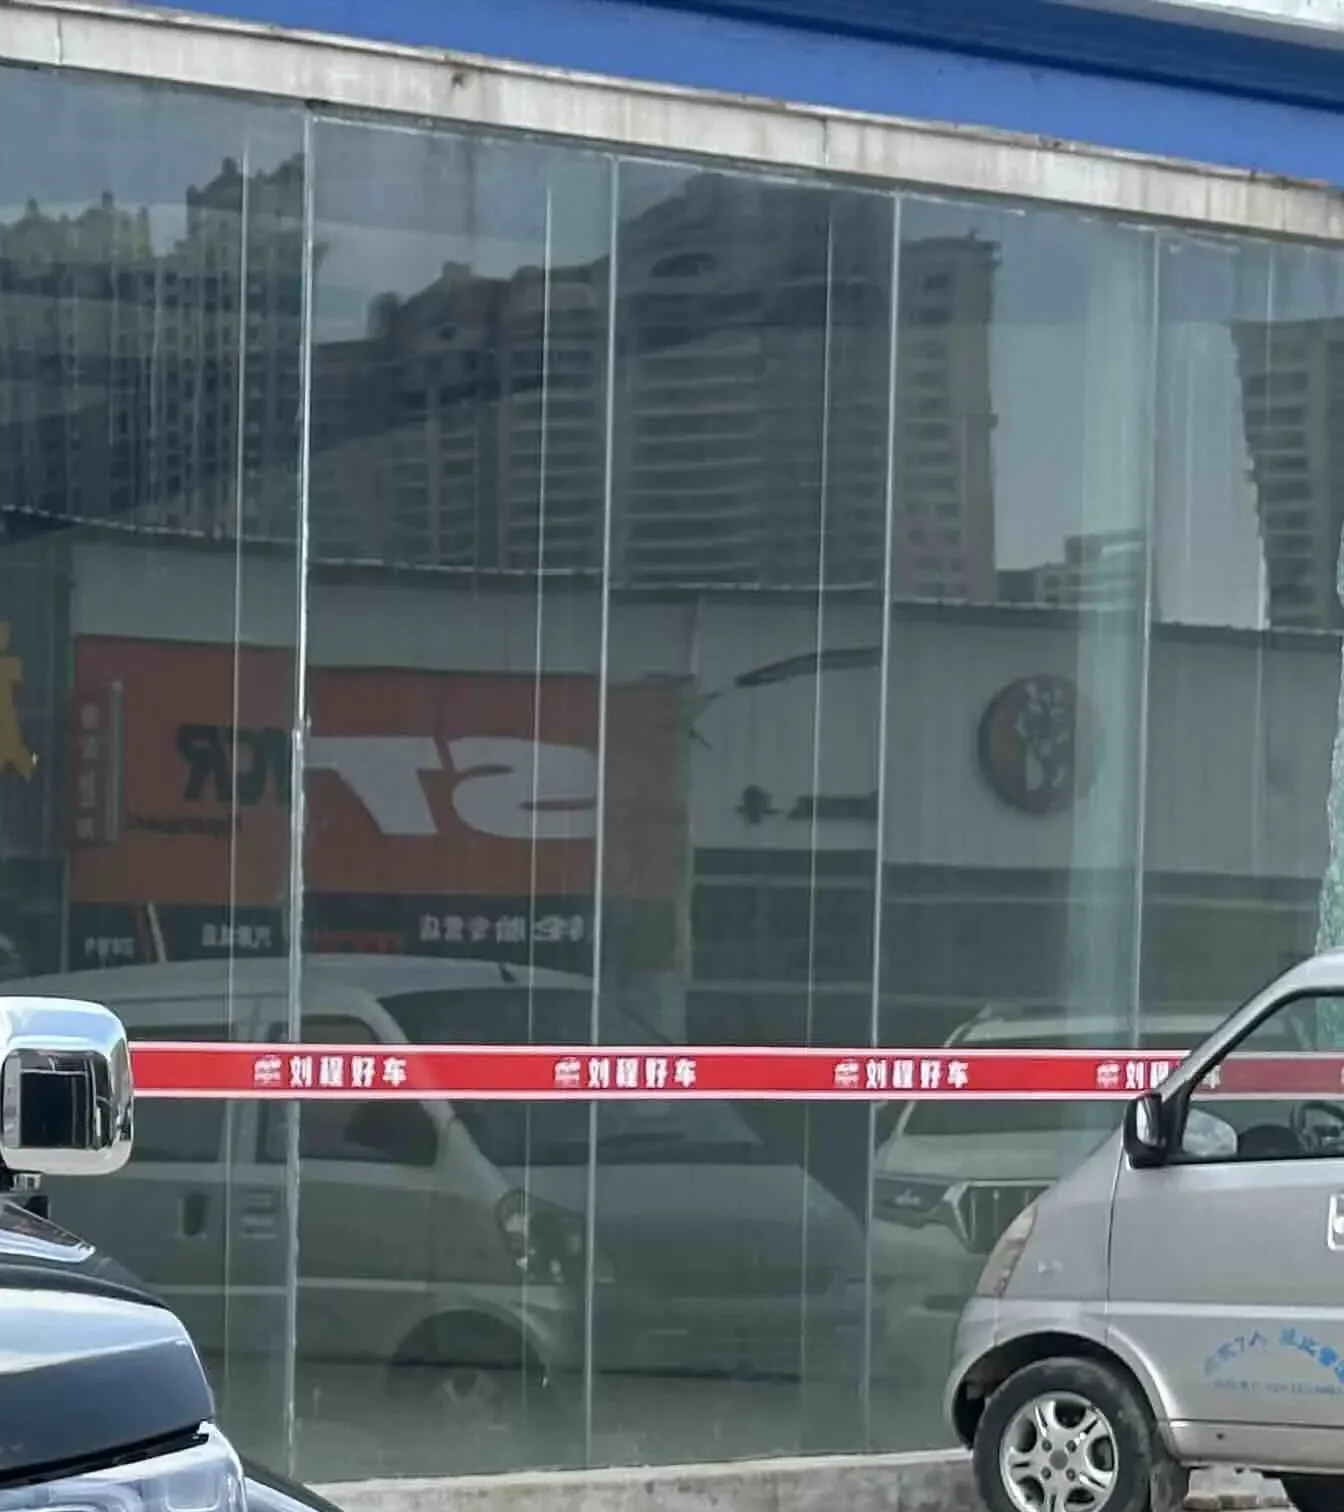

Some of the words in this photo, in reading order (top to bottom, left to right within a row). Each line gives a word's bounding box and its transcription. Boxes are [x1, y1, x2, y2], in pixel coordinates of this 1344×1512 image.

[289, 1055, 407, 1088] 刘程好车
[588, 1056, 697, 1089] 刘程好车
[865, 1057, 969, 1089] 刘程好车
